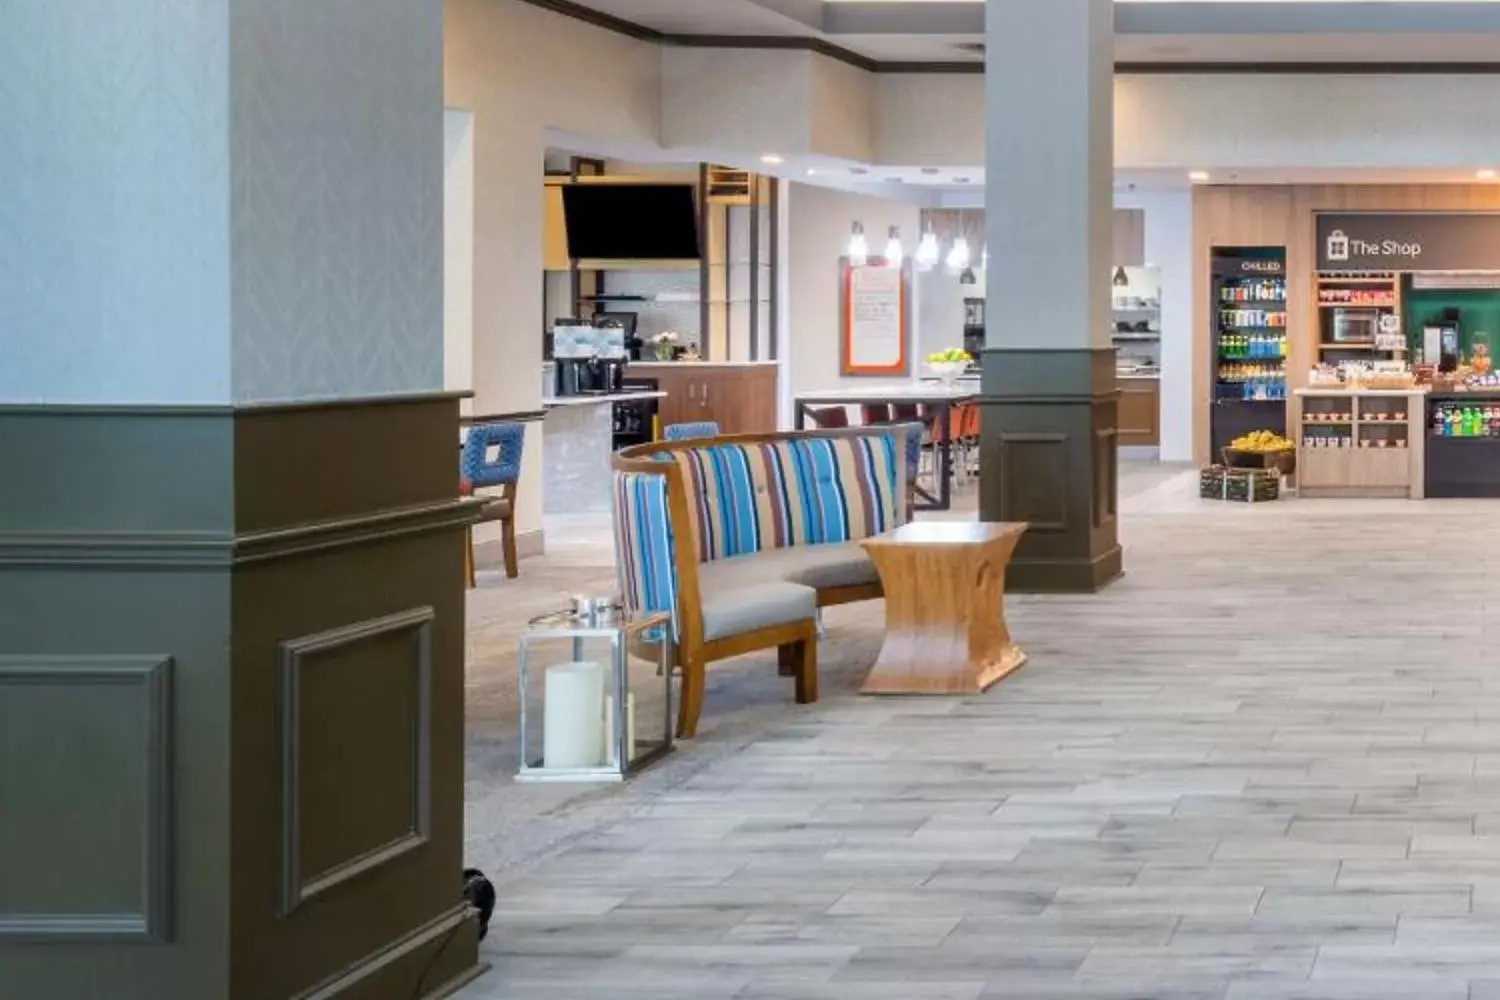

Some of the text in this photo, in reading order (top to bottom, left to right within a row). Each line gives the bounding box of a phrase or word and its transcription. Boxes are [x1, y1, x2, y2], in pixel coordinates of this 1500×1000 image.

[1350, 239, 1421, 259] The Shop
[1241, 261, 1280, 270] CHILLED
